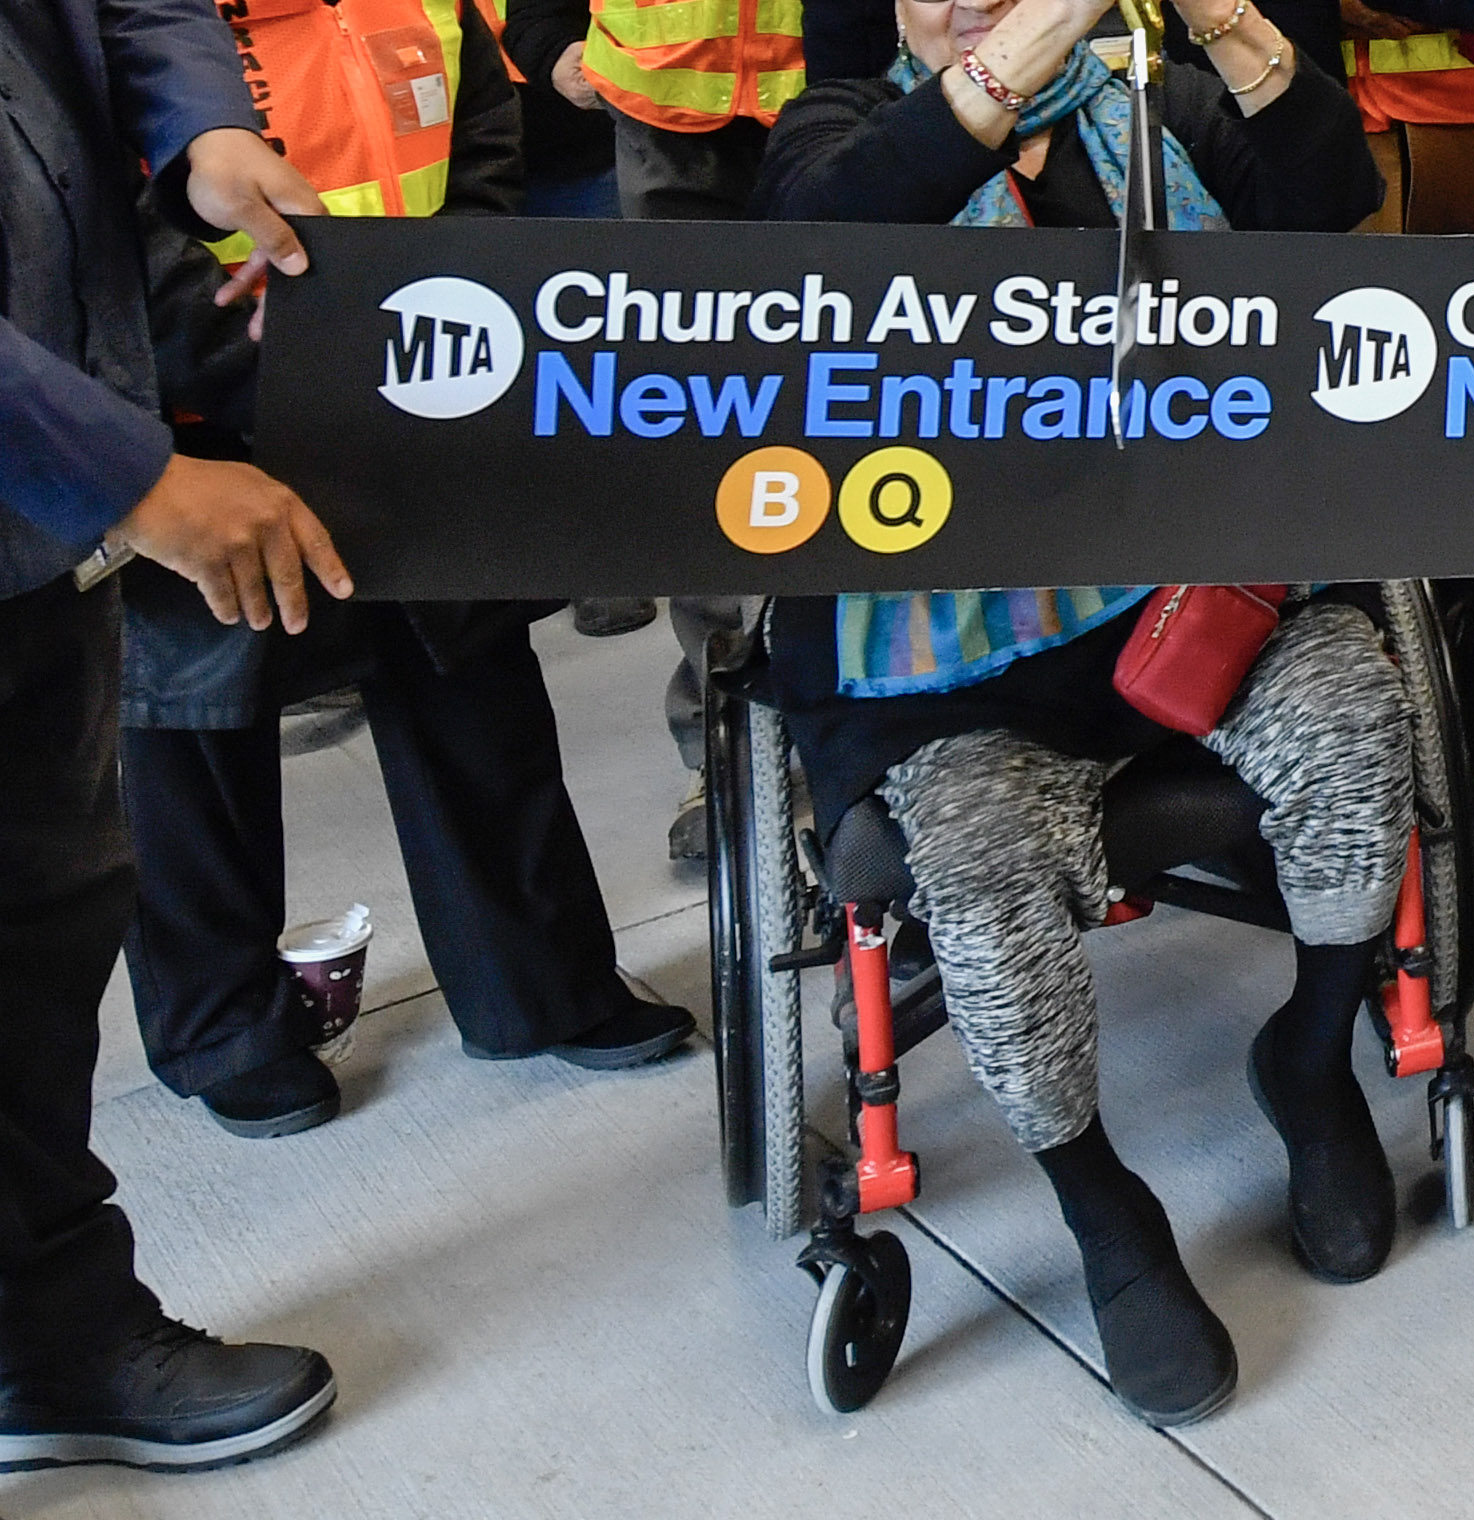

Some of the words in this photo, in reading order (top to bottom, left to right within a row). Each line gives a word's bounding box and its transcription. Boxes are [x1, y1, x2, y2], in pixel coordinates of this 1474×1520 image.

[536, 270, 852, 343] Church
[866, 275, 978, 345] Av
[989, 277, 1278, 348] Station
[534, 350, 784, 438] New
[804, 351, 1272, 440] Entrance
[749, 471, 799, 527] B
[869, 472, 924, 528] Q
